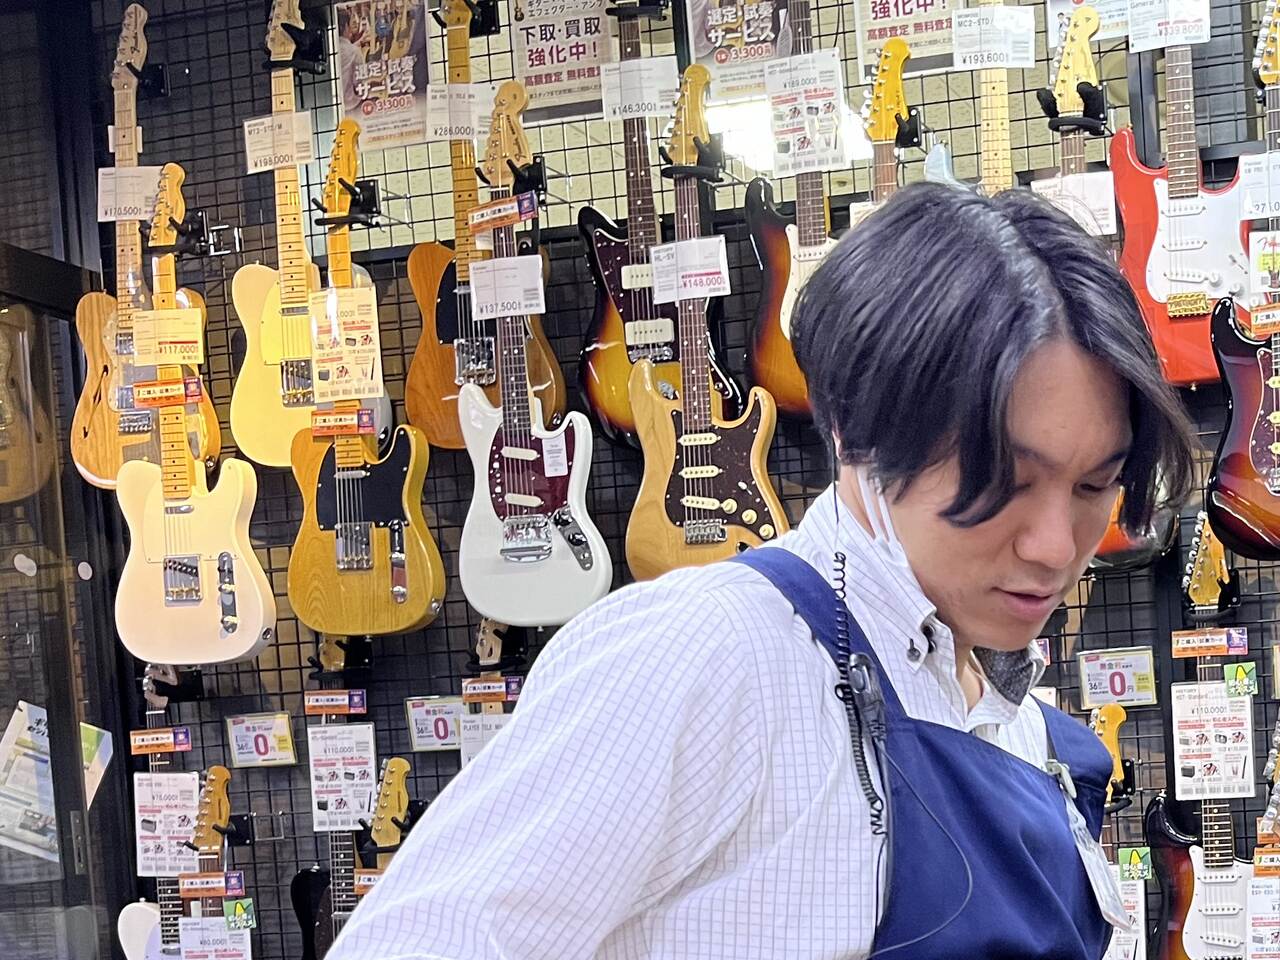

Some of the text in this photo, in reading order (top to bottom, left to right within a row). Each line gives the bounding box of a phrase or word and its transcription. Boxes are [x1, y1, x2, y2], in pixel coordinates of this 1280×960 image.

[519, 16, 602, 45] 下取・買取
[708, 21, 774, 48] サービス
[355, 75, 416, 100] サービス
